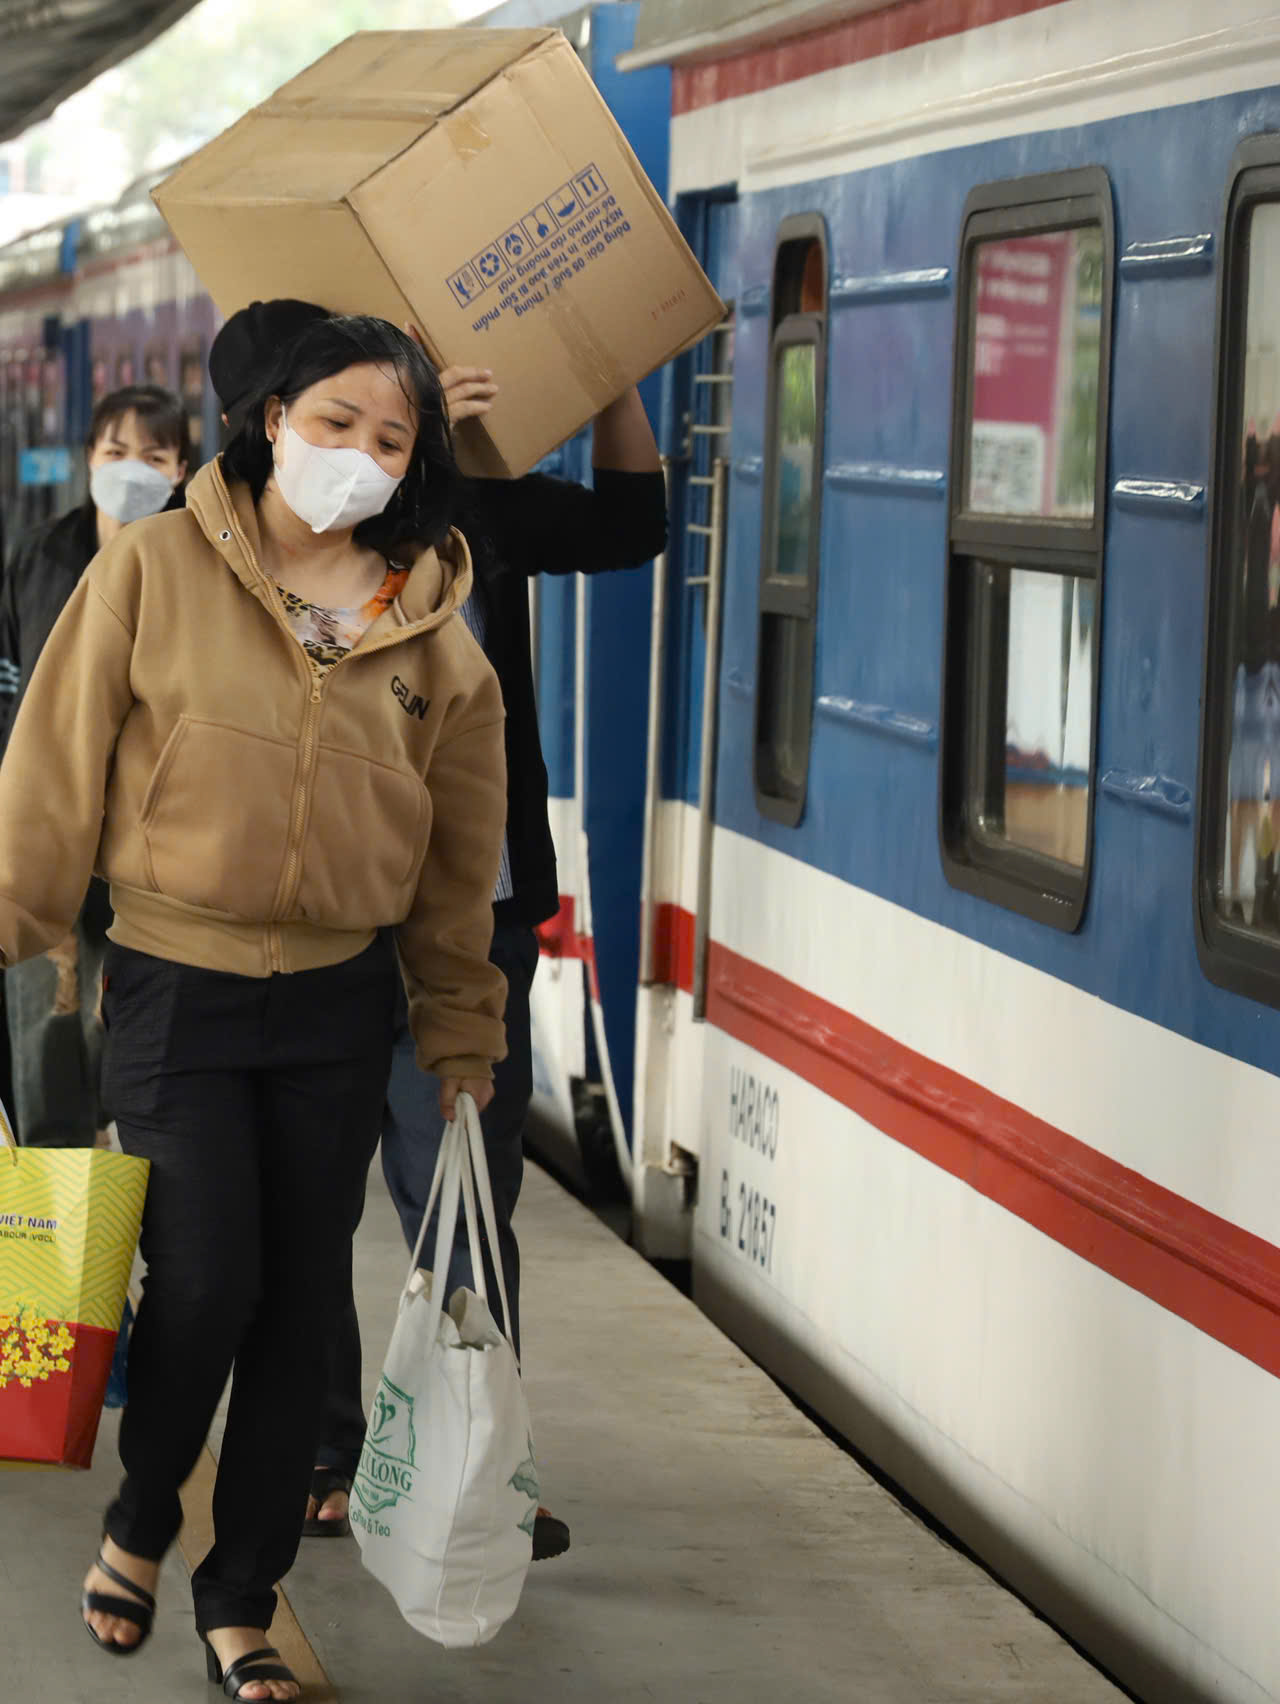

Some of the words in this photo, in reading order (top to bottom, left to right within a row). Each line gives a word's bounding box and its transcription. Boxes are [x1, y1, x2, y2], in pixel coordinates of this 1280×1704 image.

[729, 1064, 780, 1161] HARACO
[27, 1218, 57, 1230] NAM
[371, 1457, 413, 1492] LONG
[374, 1519, 391, 1537] Tea
